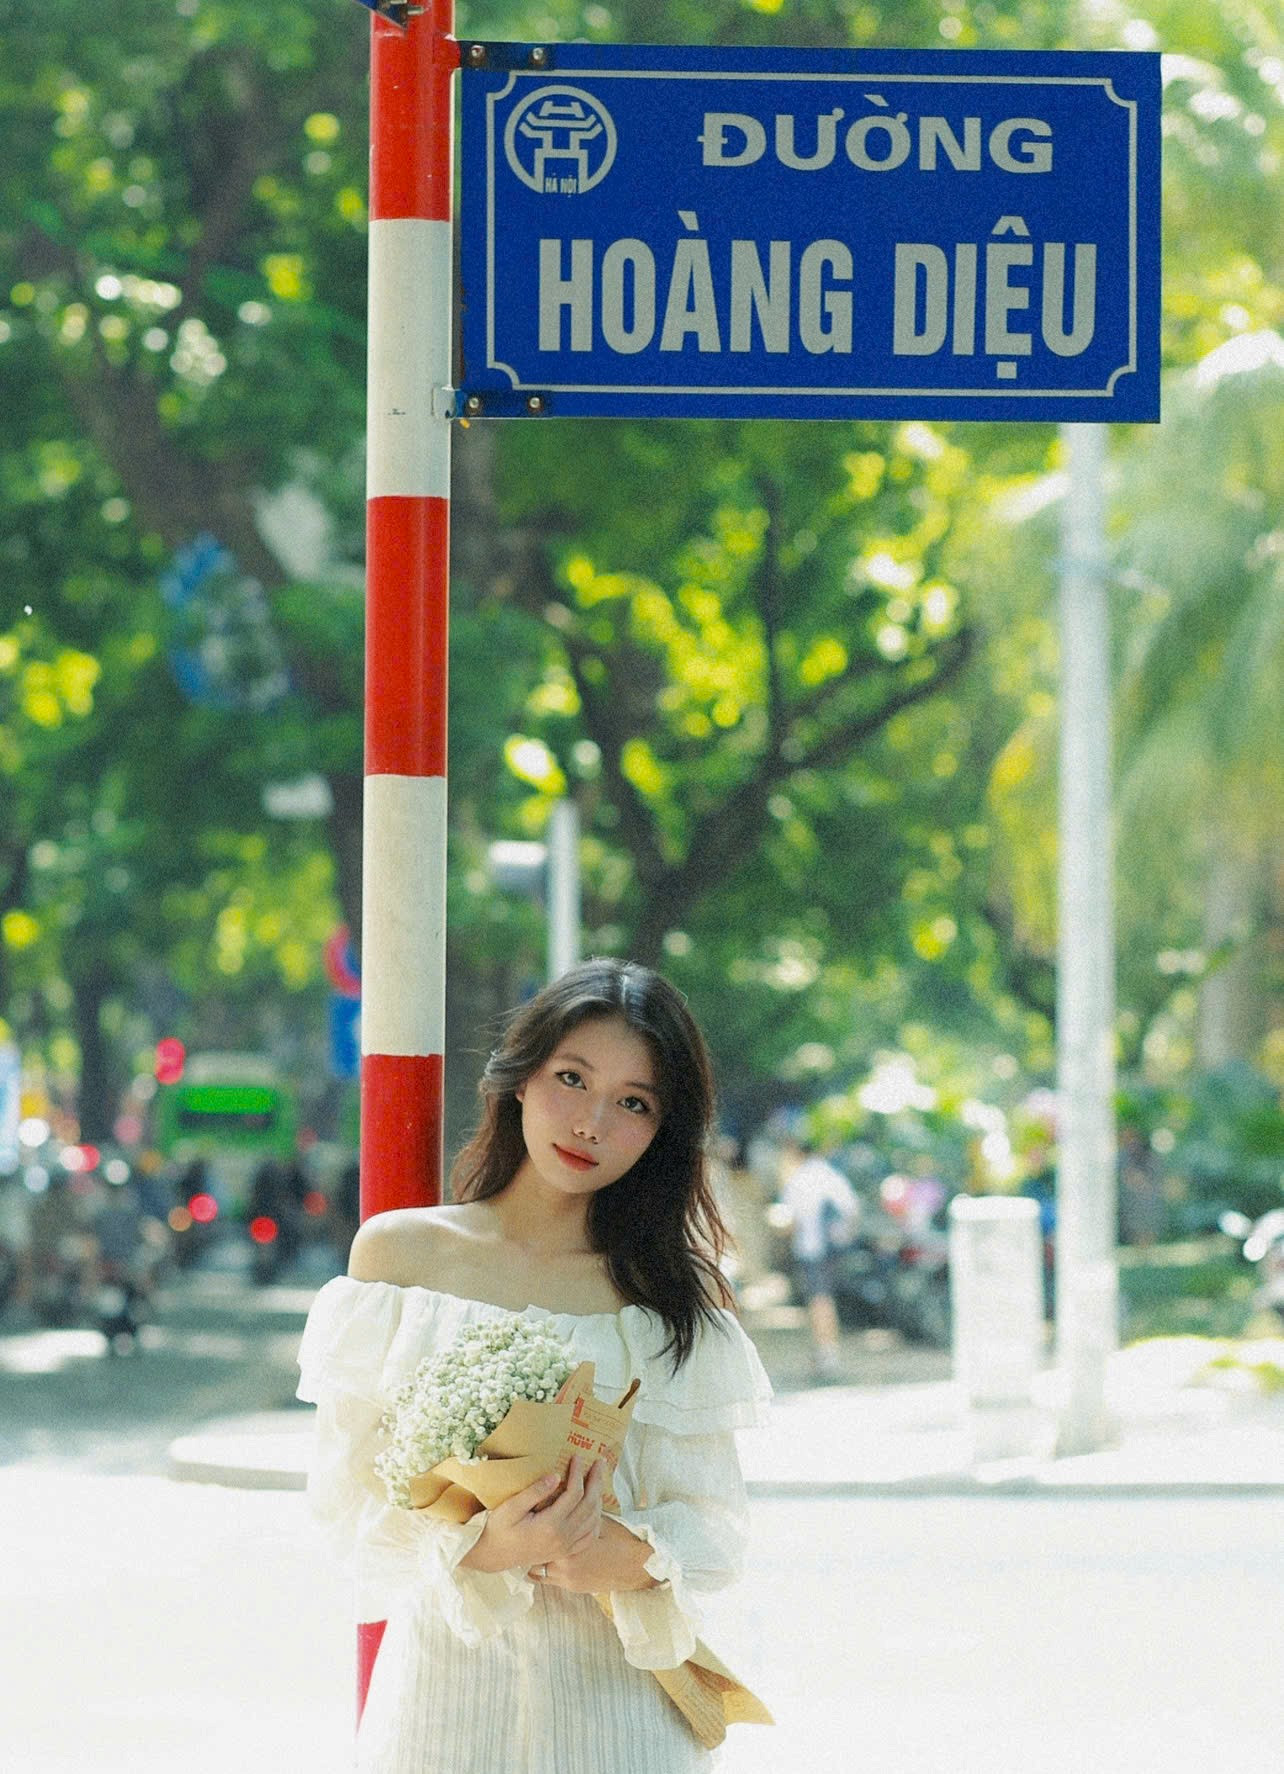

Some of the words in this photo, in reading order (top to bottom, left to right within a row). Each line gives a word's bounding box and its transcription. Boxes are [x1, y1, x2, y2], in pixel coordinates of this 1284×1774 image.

[698, 95, 1052, 173] ĐƯỜNG
[539, 211, 852, 353] HOÀNG
[894, 216, 1096, 378] DIỆU
